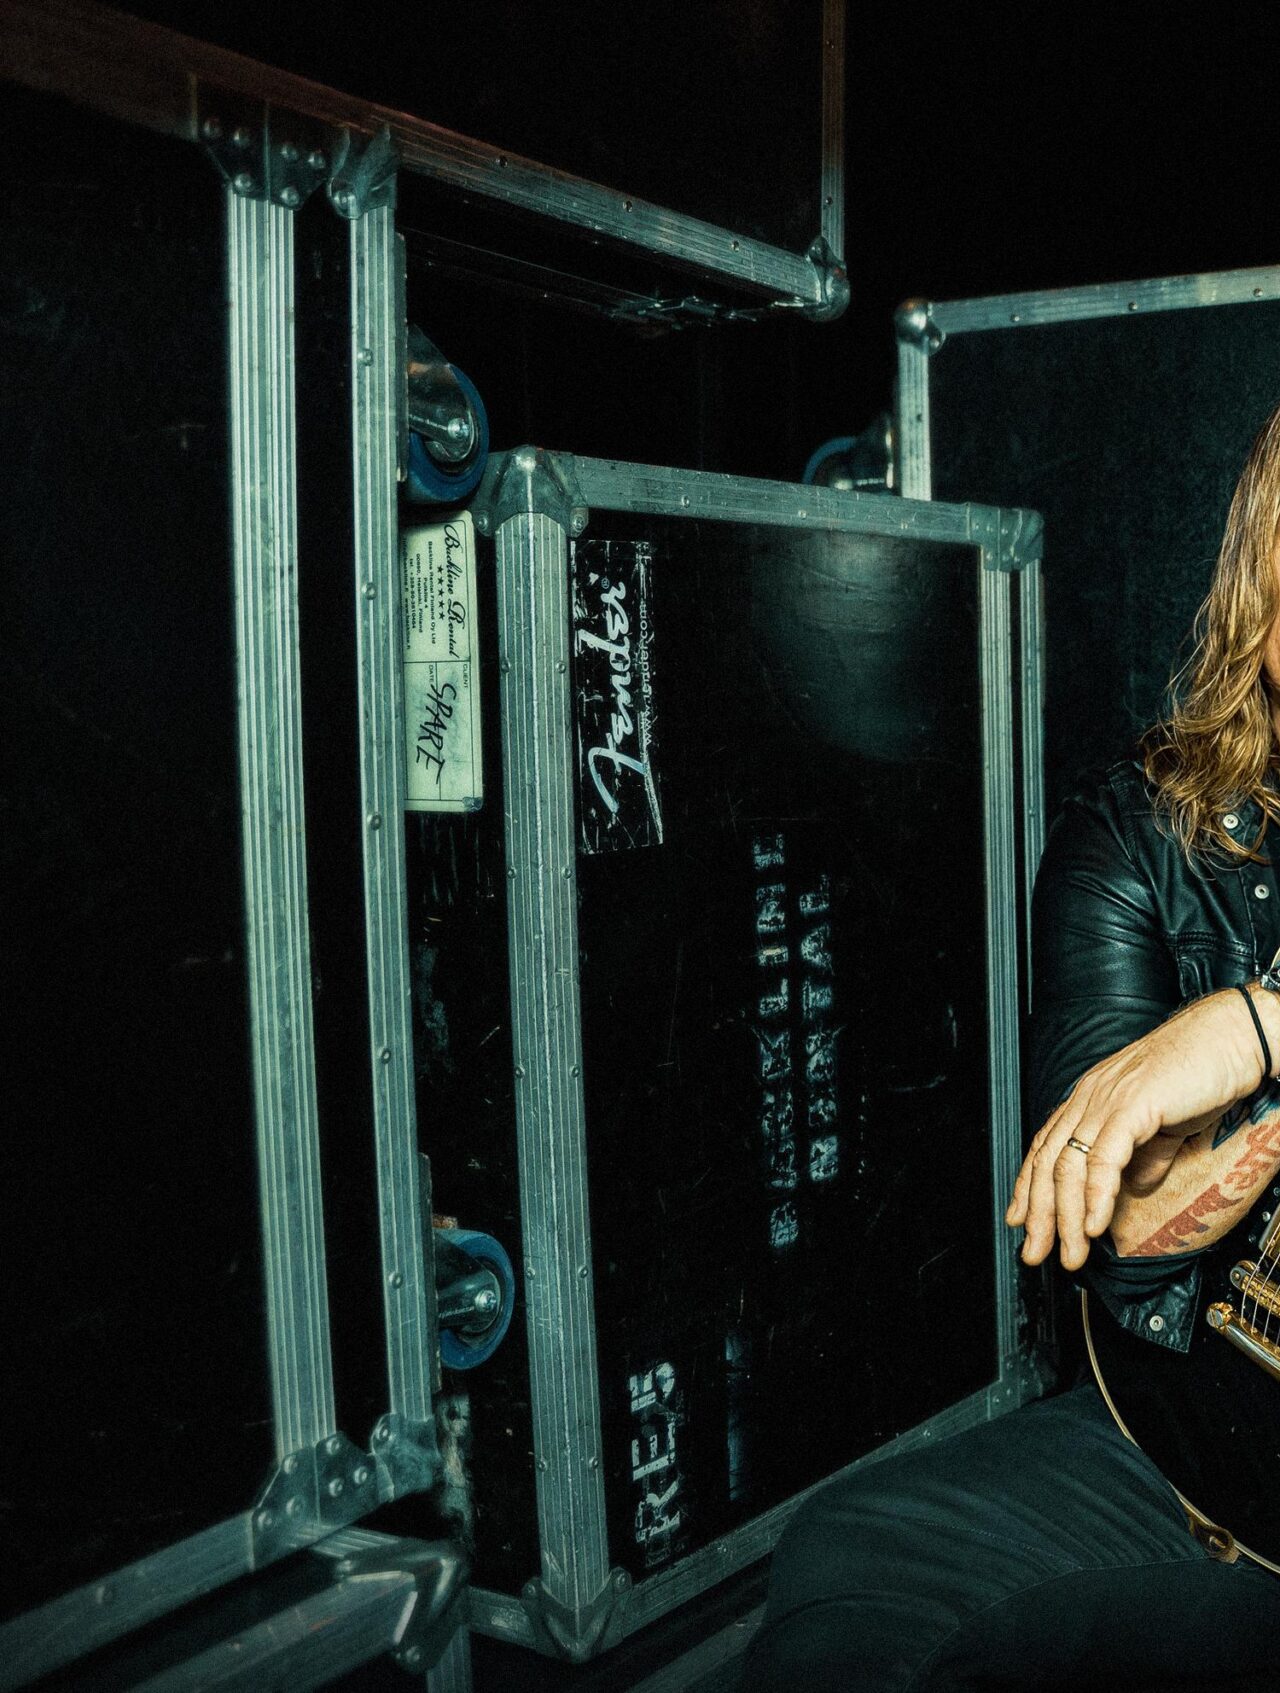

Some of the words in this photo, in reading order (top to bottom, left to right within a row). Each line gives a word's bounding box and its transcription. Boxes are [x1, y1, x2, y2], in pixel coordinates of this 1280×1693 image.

[443, 524, 464, 595] Backline
[447, 598, 466, 659] Rental
[416, 683, 457, 785] SPARE
[577, 581, 646, 813] Fender
